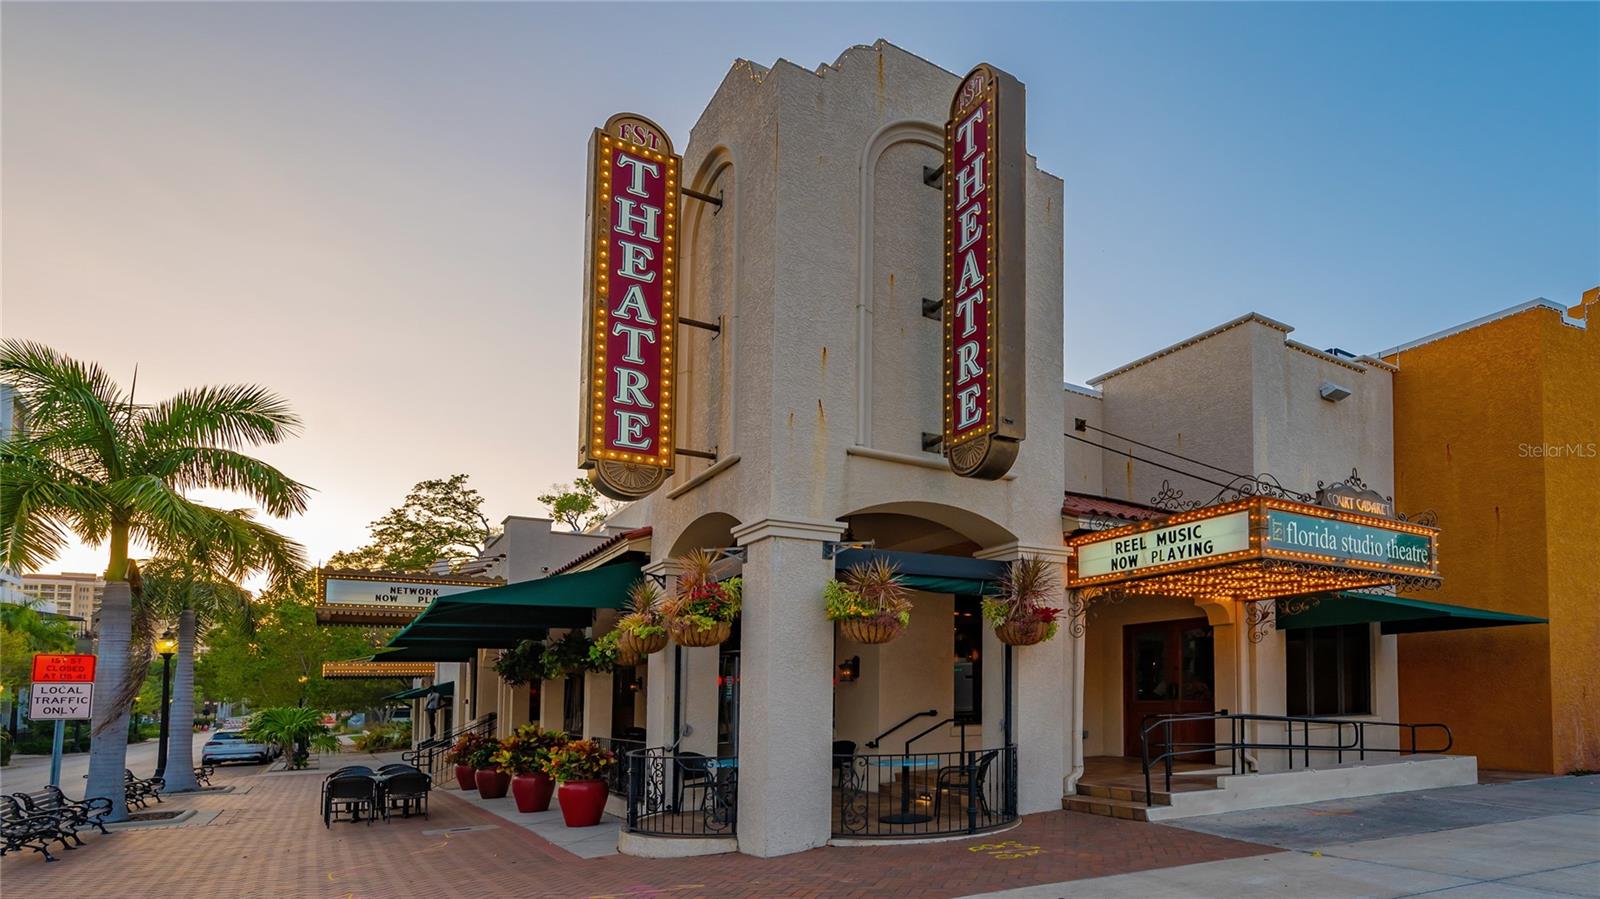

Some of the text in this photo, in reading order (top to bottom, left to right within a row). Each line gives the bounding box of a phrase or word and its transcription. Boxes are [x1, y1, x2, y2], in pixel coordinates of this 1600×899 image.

[618, 123, 662, 151] FST
[956, 106, 986, 431] THEATRE
[612, 153, 661, 450] THEATRE
[1115, 525, 1202, 555] REEL MUSIC
[1286, 521, 1429, 564] florida studio theatre
[1111, 540, 1213, 571] NOW PLAYING
[375, 594, 398, 602] NOW
[389, 586, 439, 596] NETWORK
[34, 696, 88, 704] TRAFFIC
[41, 686, 83, 694] LOCAL
[42, 706, 78, 715] ONLY
